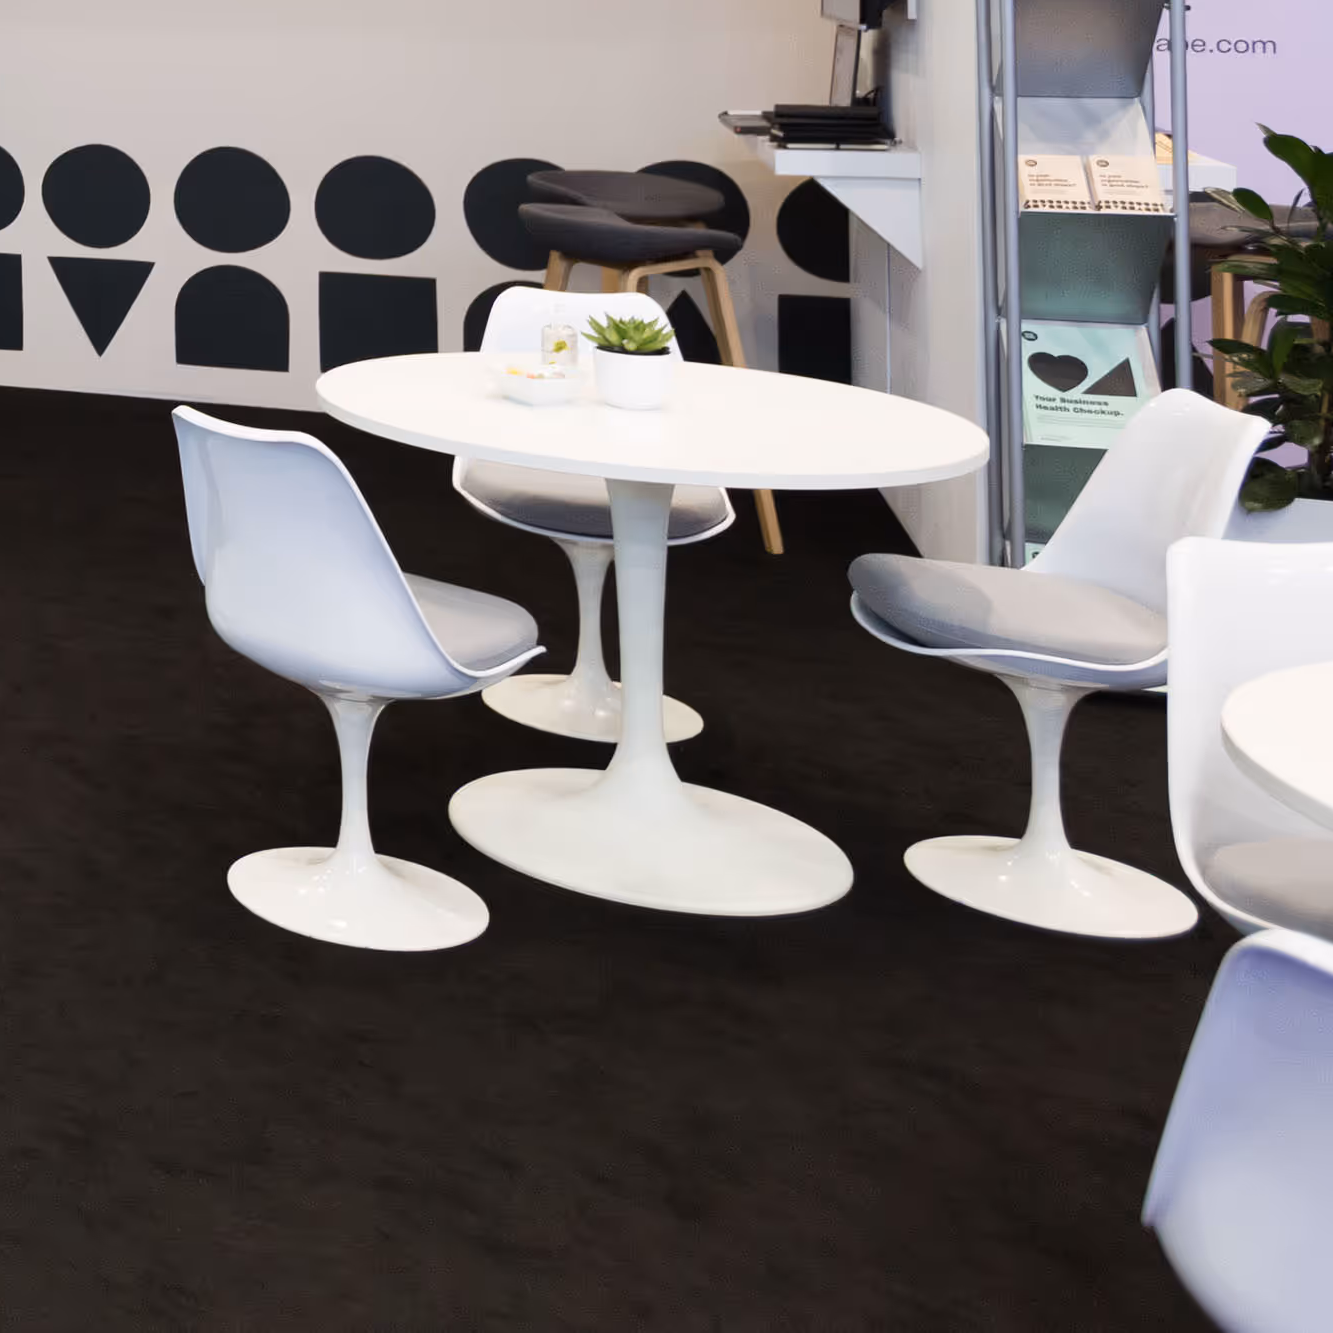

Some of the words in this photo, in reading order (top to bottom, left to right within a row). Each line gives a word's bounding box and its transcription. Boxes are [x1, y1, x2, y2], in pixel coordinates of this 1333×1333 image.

[1035, 394, 1056, 403] Your
[1059, 397, 1109, 407] Business
[1035, 403, 1070, 413] Health
